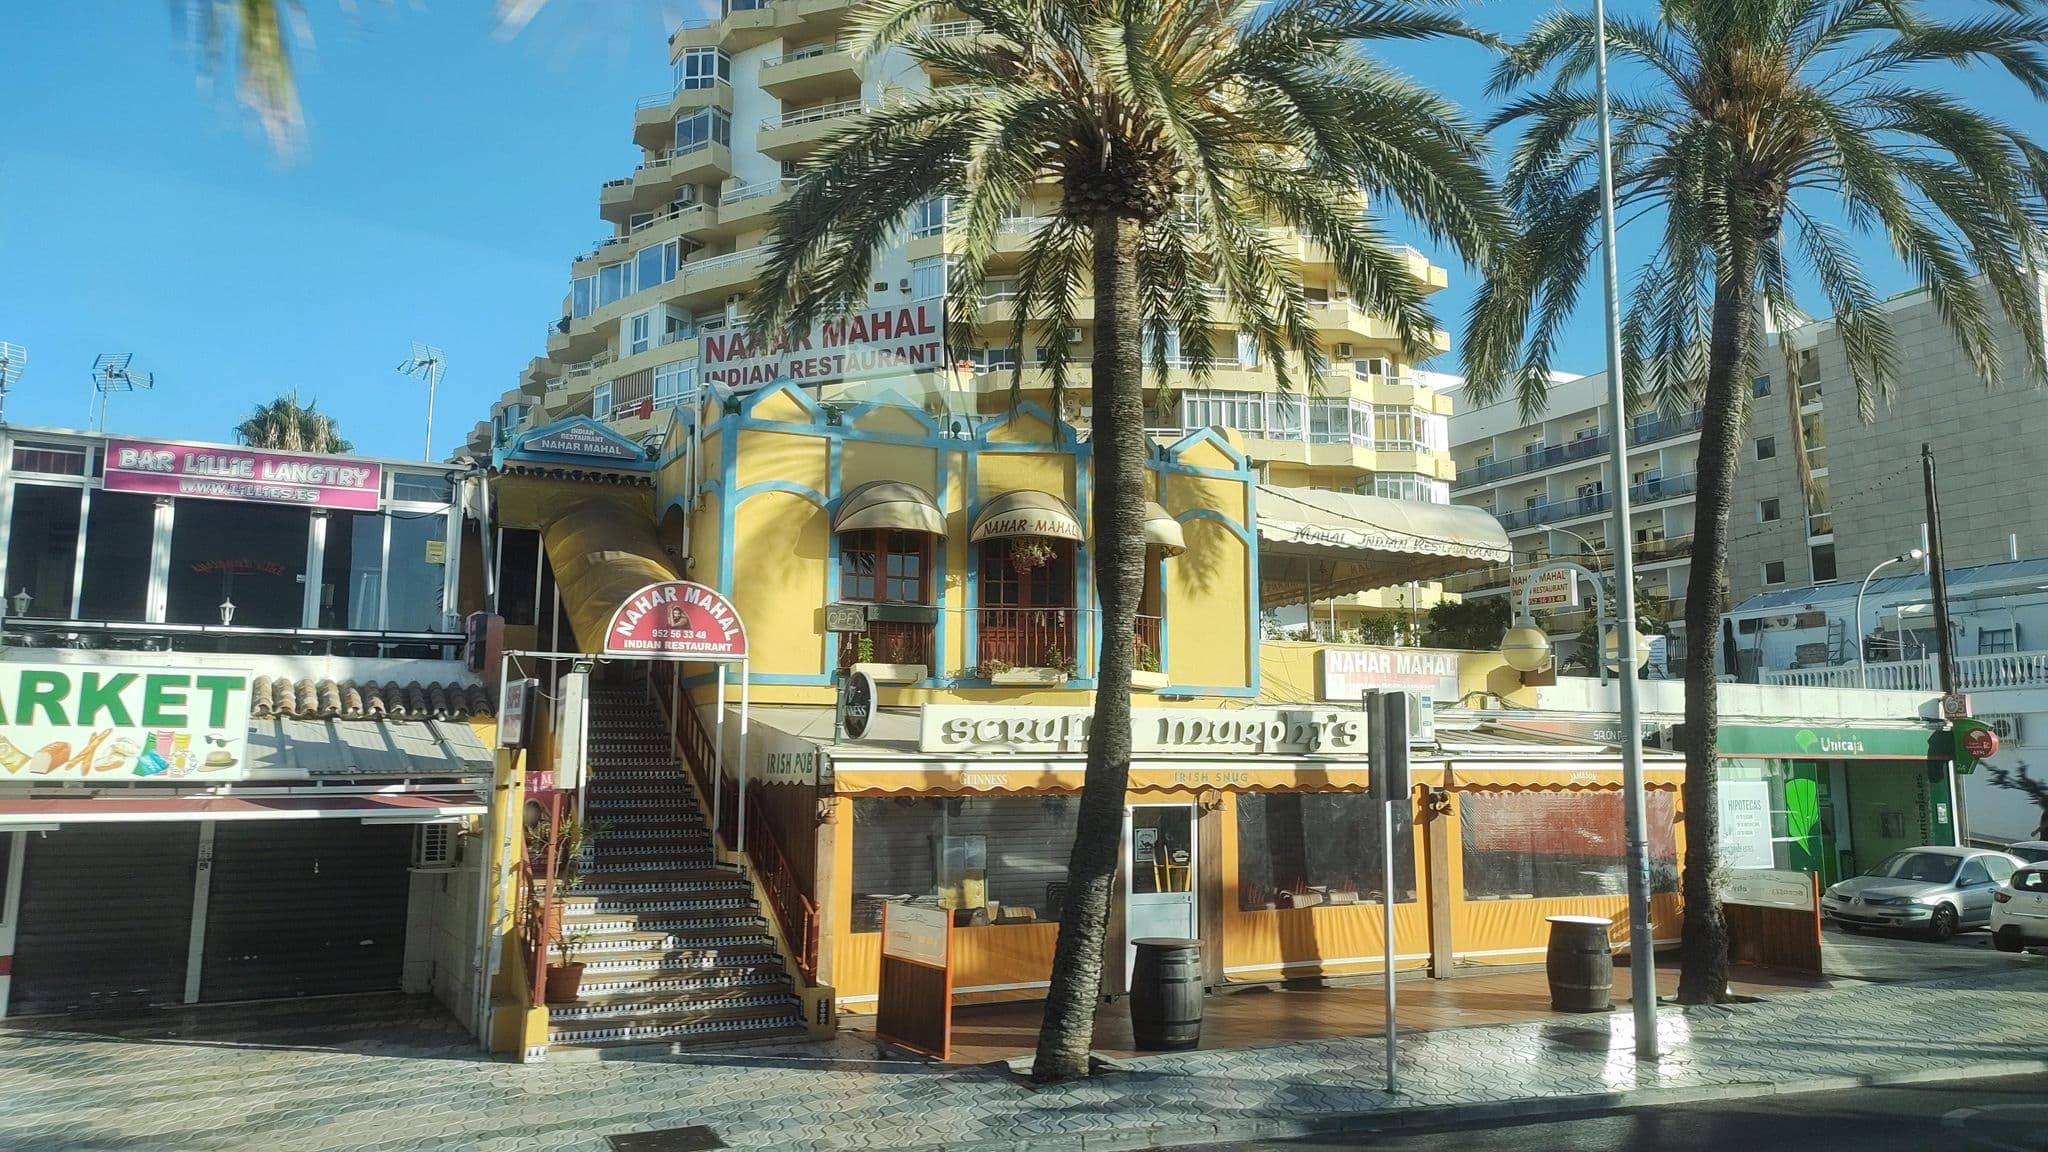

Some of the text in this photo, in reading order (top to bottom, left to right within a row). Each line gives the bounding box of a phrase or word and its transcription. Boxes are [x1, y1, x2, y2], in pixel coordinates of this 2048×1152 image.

[822, 305, 936, 349] MAHAL
[704, 341, 940, 388] INDIAN RESTAURANT
[560, 433, 604, 443] RESTAURANT
[571, 428, 595, 436] INDIAN
[541, 440, 622, 455] NAHAR MAHAL
[118, 447, 176, 473] BAR
[262, 460, 371, 488] LANGTRY
[1540, 570, 1566, 582] MAHAL
[1533, 583, 1568, 595] RESTAURANT
[616, 586, 740, 641] NAHAR MAHAL
[828, 611, 865, 626] OPEN
[652, 629, 707, 640] 952 56 33 48
[624, 640, 733, 652] INDIAN RESTAURANT
[1330, 652, 1457, 675] NAHAR MAHAL
[1821, 735, 1864, 755] Unicaja
[767, 752, 813, 774] IRISH PUB
[1174, 771, 1248, 782] IRISH SNUG
[1728, 799, 1761, 810] HIPOTECAS
